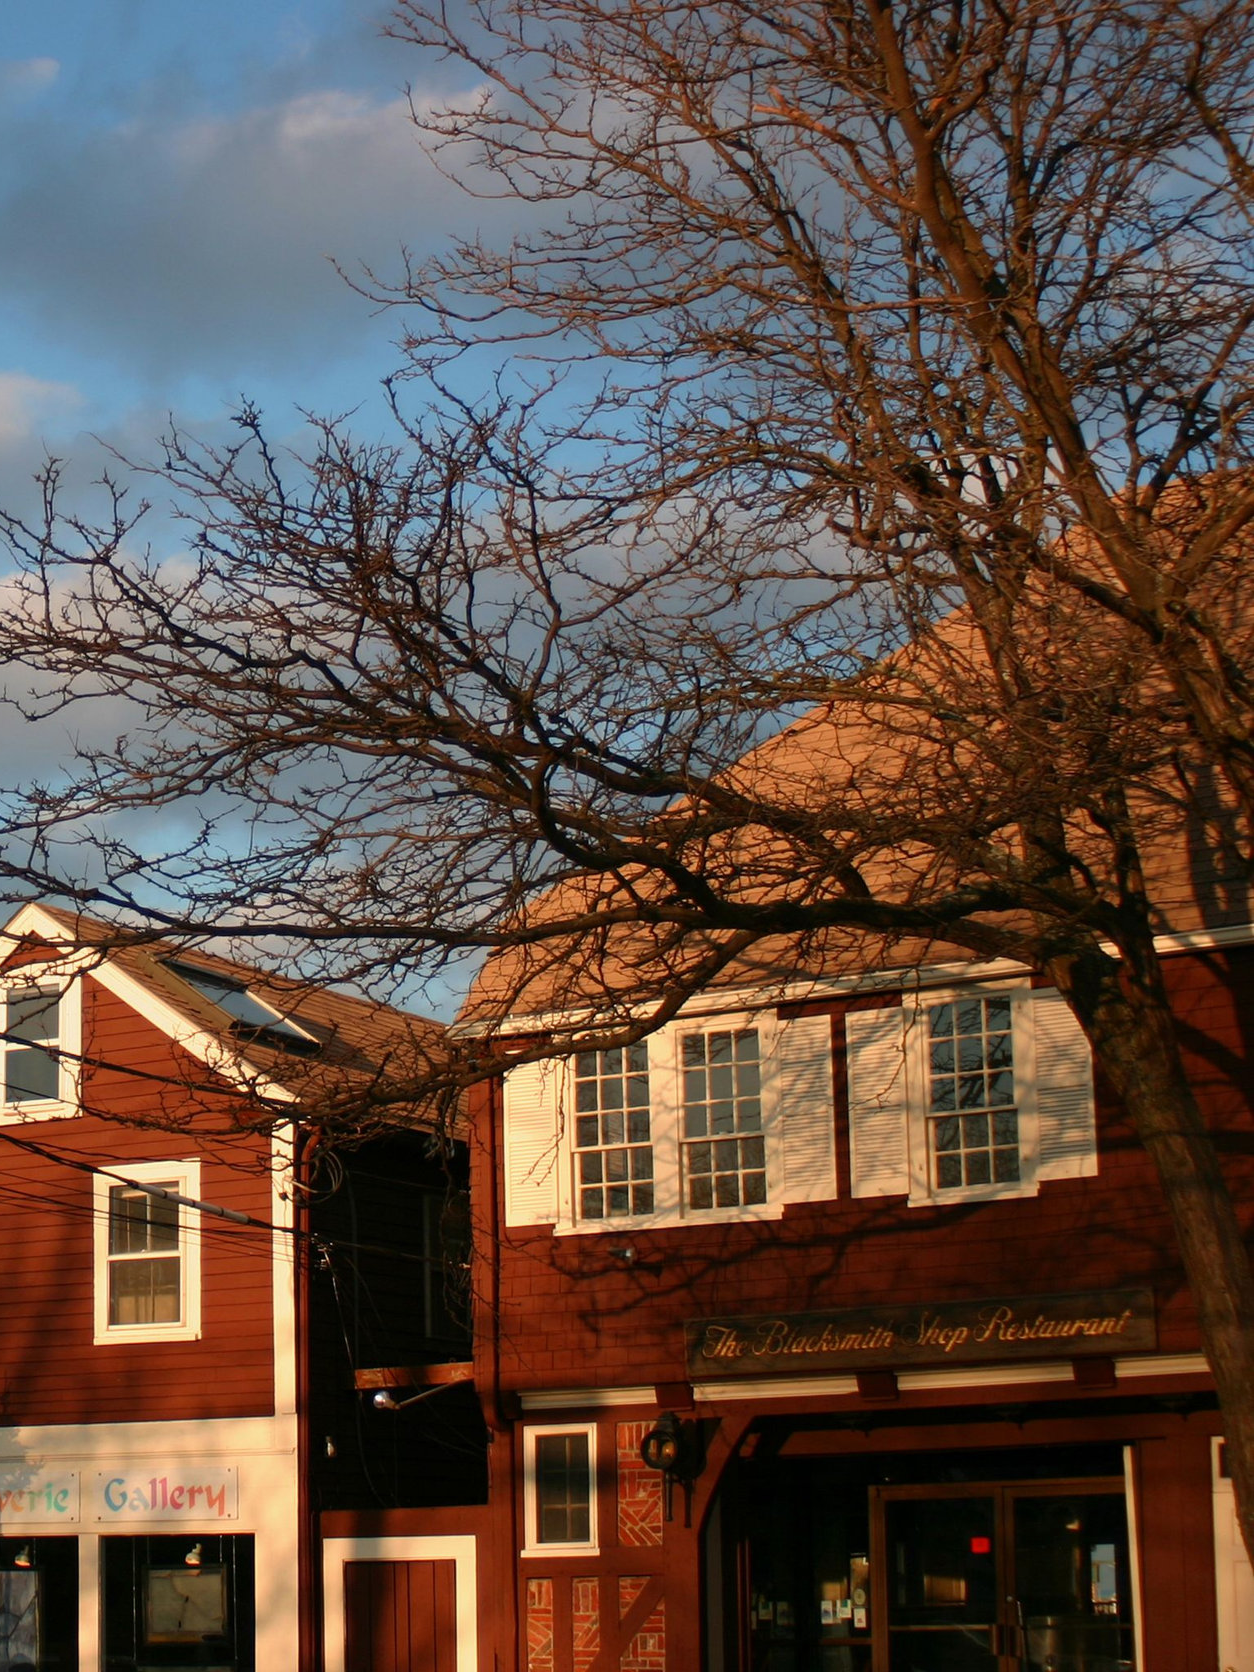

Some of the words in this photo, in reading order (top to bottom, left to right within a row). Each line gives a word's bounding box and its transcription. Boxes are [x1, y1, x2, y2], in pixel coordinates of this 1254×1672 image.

[702, 1325, 746, 1358] The
[752, 1320, 894, 1355] Blacksmith
[901, 1311, 969, 1352] Shop
[973, 1306, 1133, 1342] Restaurant
[104, 1476, 226, 1517] Gallery
